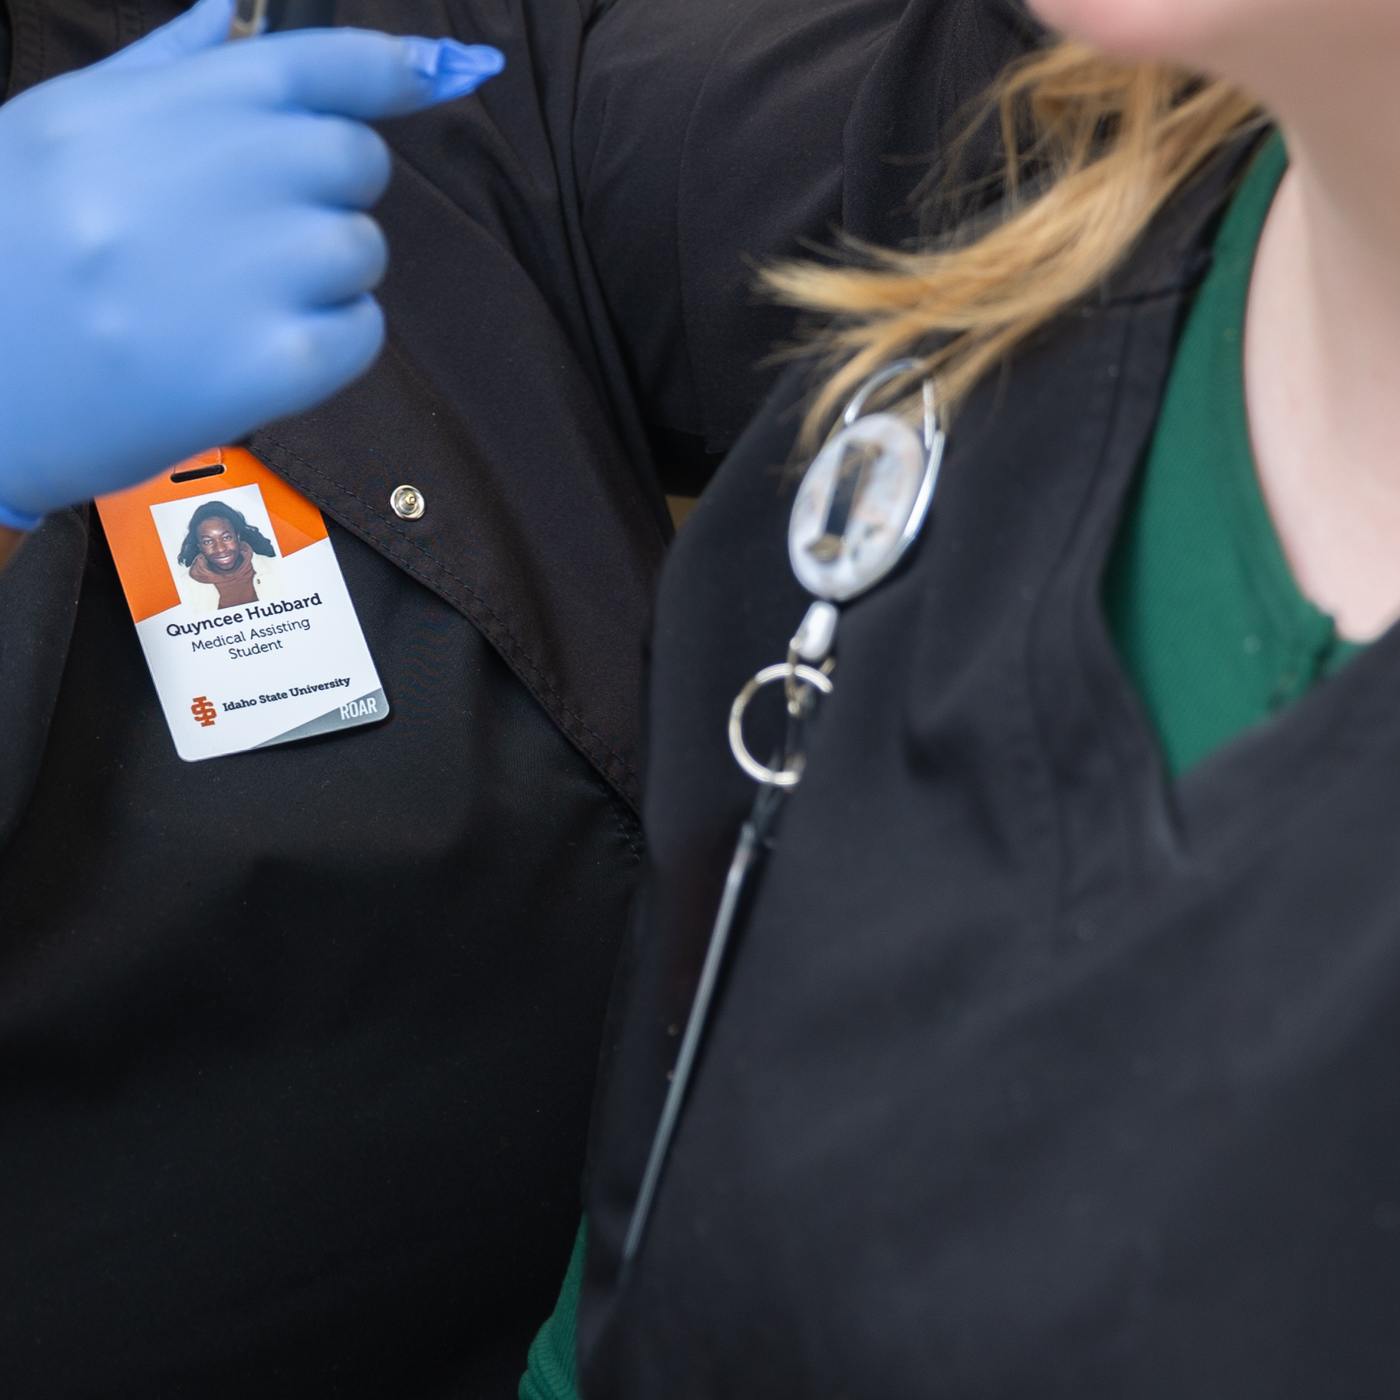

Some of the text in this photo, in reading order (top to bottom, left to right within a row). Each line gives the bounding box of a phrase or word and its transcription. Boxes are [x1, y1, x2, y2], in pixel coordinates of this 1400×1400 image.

[166, 593, 323, 637] Quyncee Hubbard
[191, 618, 311, 652] Medical Assisting
[228, 639, 283, 659] Student
[222, 677, 351, 712] Idaho State University
[339, 697, 378, 720] ROAR
